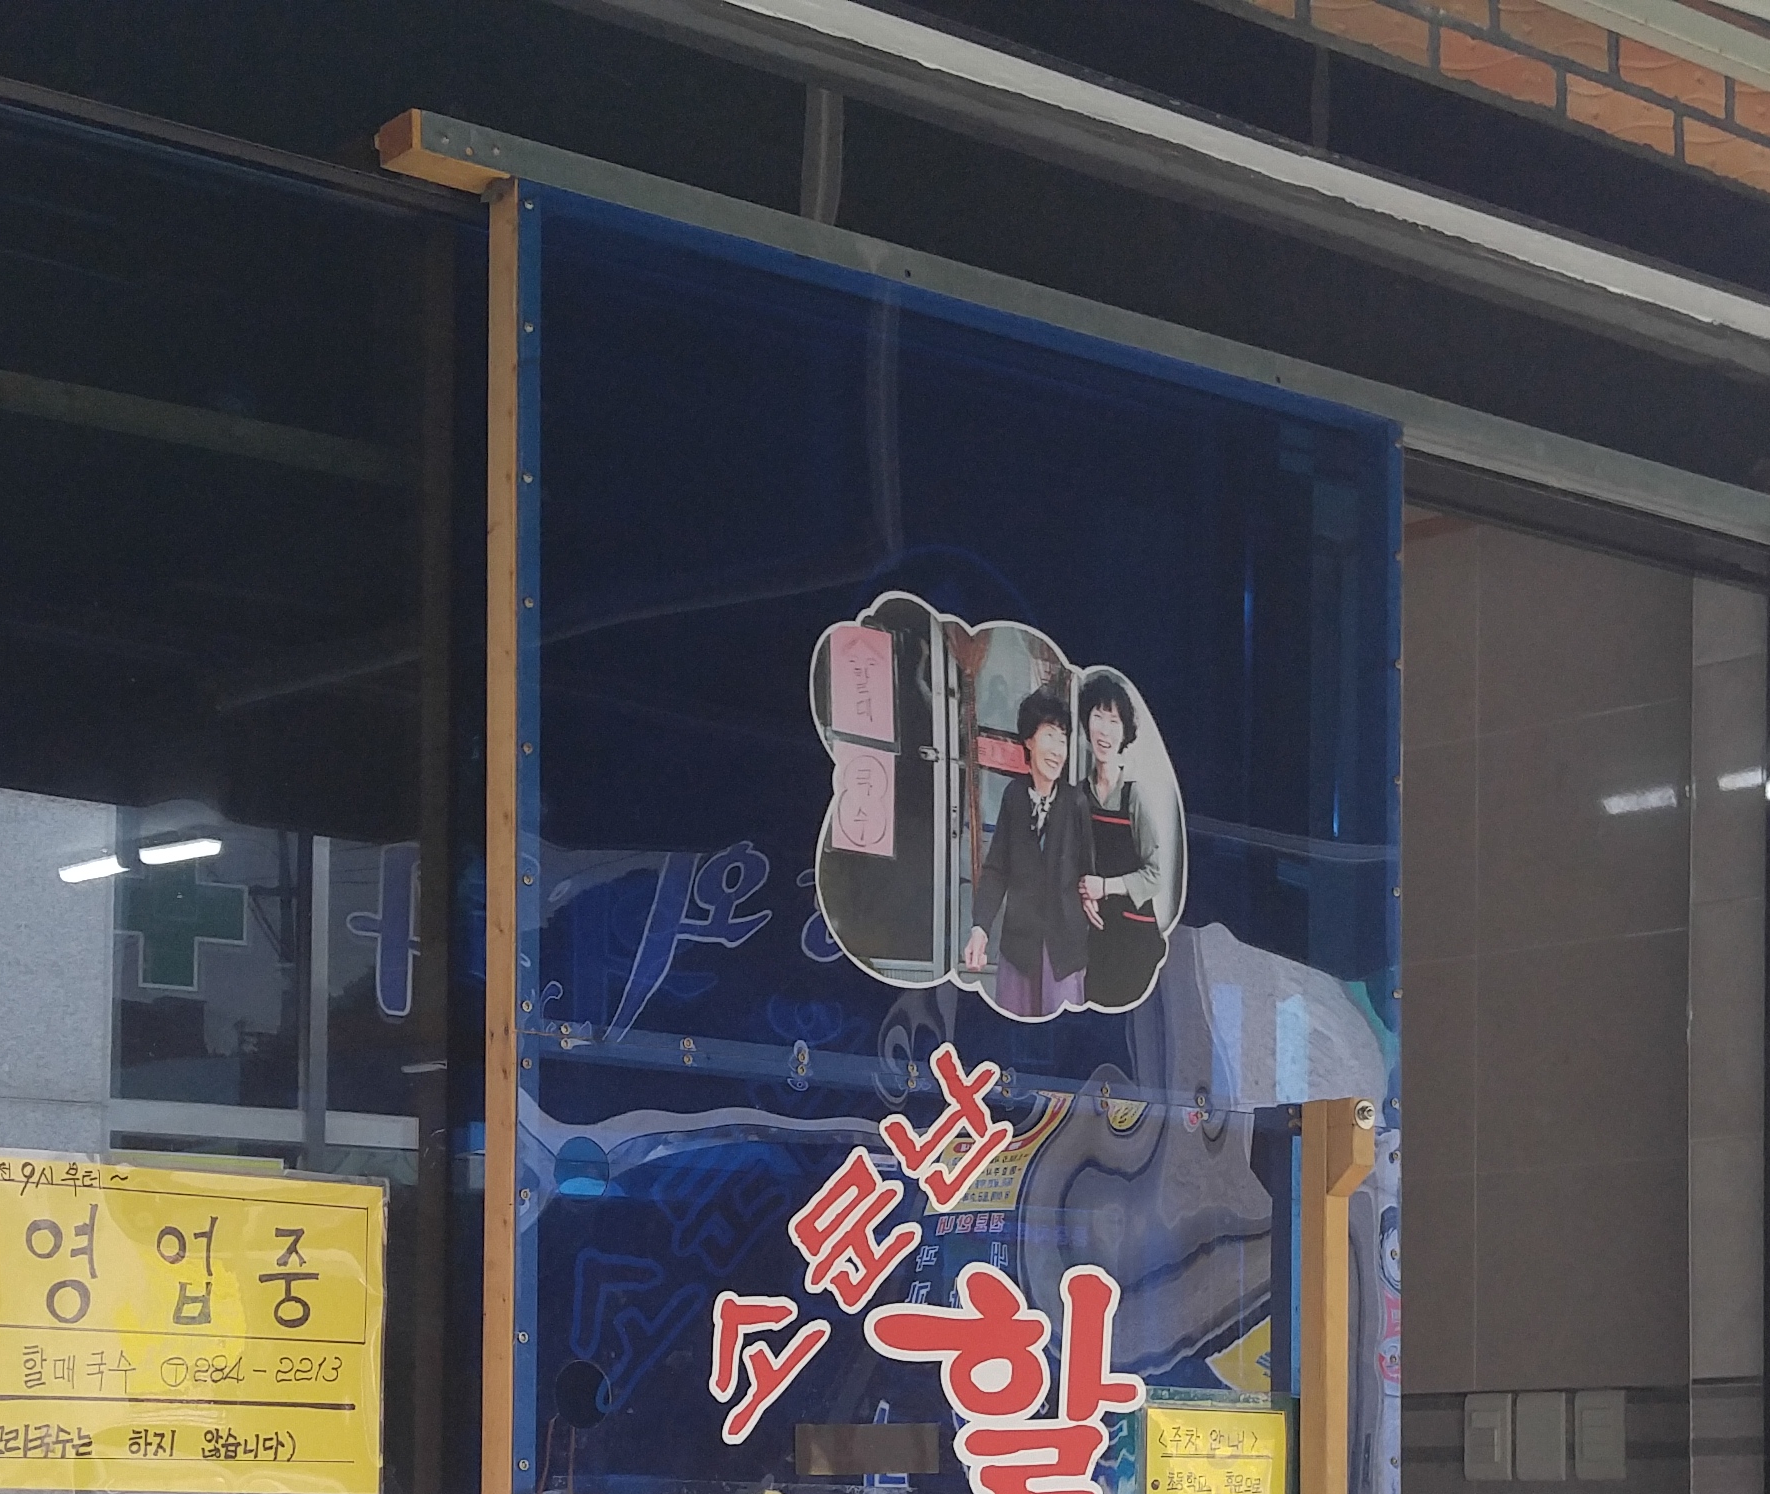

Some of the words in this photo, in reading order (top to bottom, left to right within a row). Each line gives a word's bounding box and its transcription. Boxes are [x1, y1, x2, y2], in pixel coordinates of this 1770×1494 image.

[20, 1162, 53, 1196] 9시
[129, 1428, 175, 1458] 하지
[202, 1427, 296, 1461] 않습니다)
